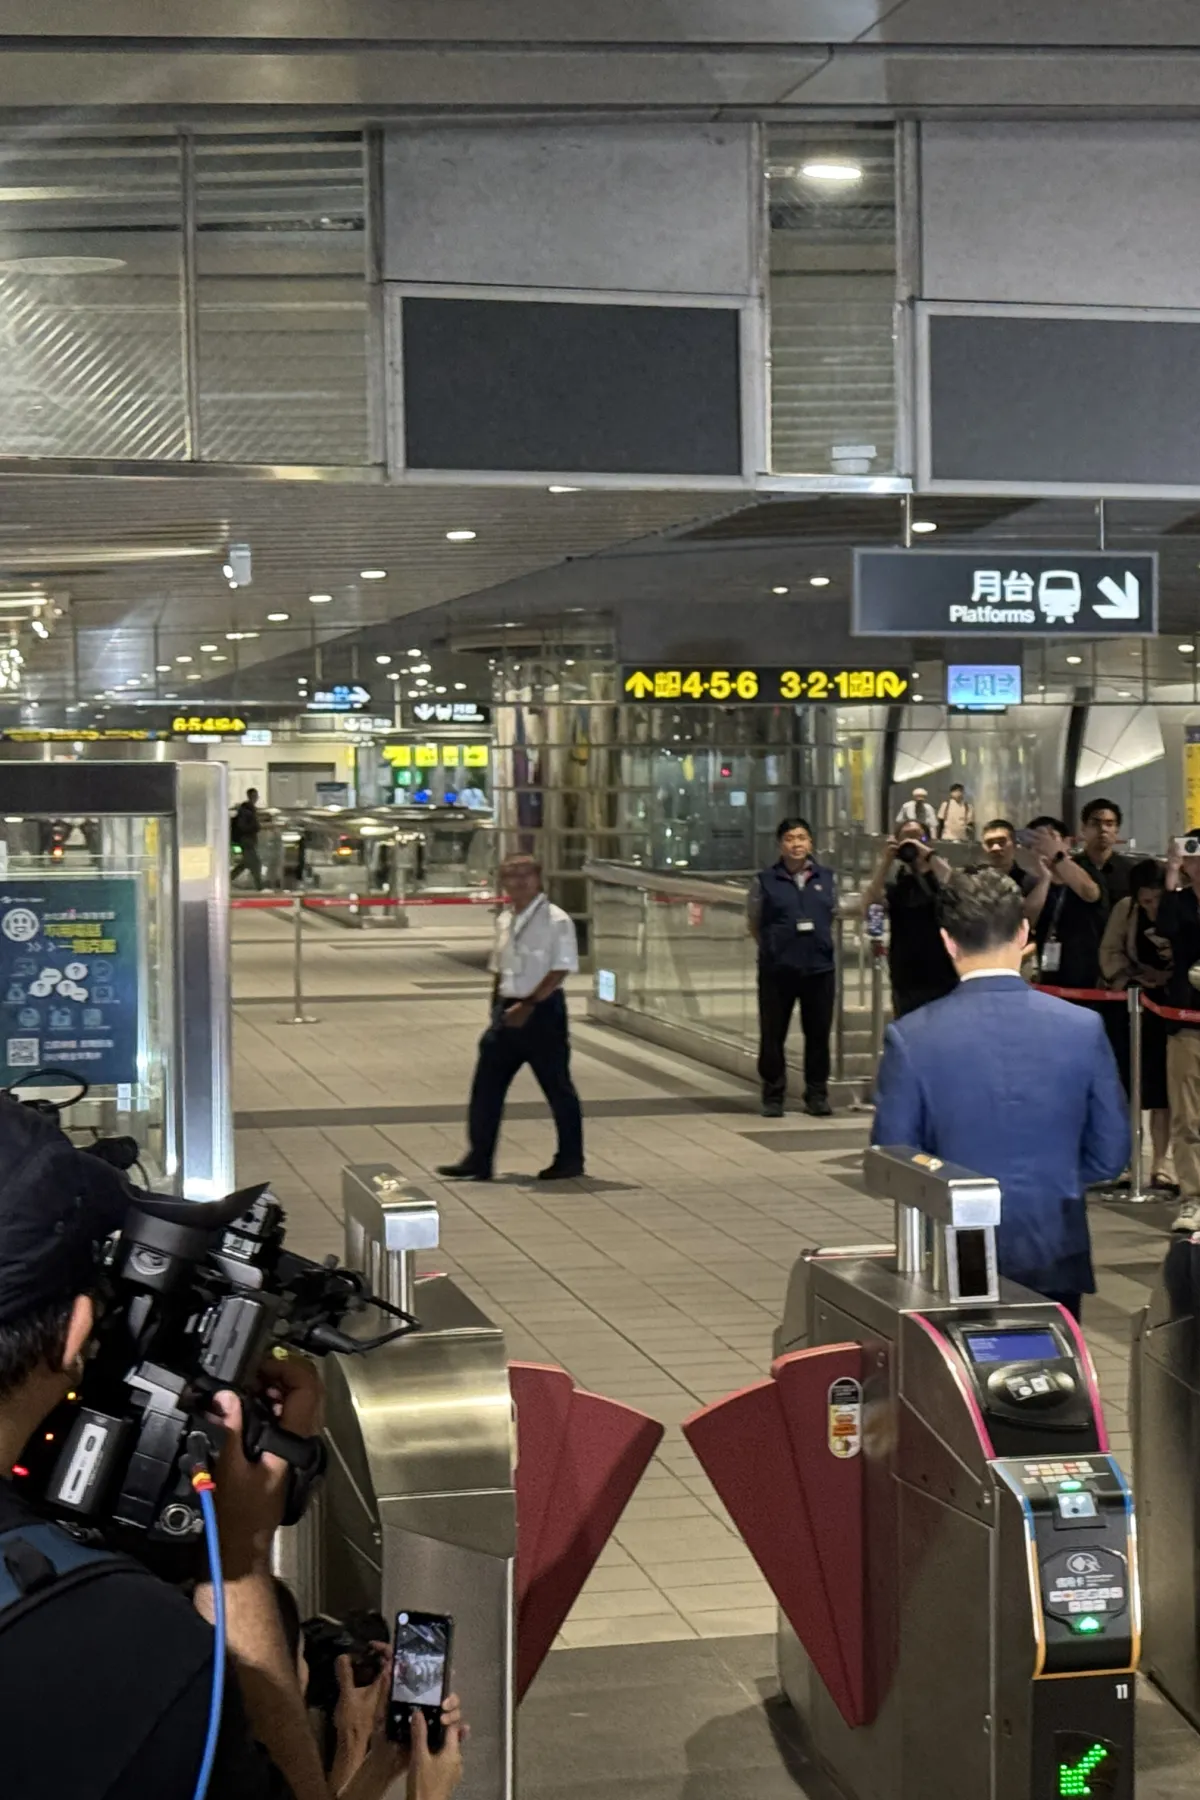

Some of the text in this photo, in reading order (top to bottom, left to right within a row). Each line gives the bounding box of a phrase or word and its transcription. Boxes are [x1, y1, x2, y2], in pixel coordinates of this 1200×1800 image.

[971, 570, 1035, 603] 月台
[949, 604, 1036, 624] Platforms
[1115, 1683, 1128, 1700] 11
